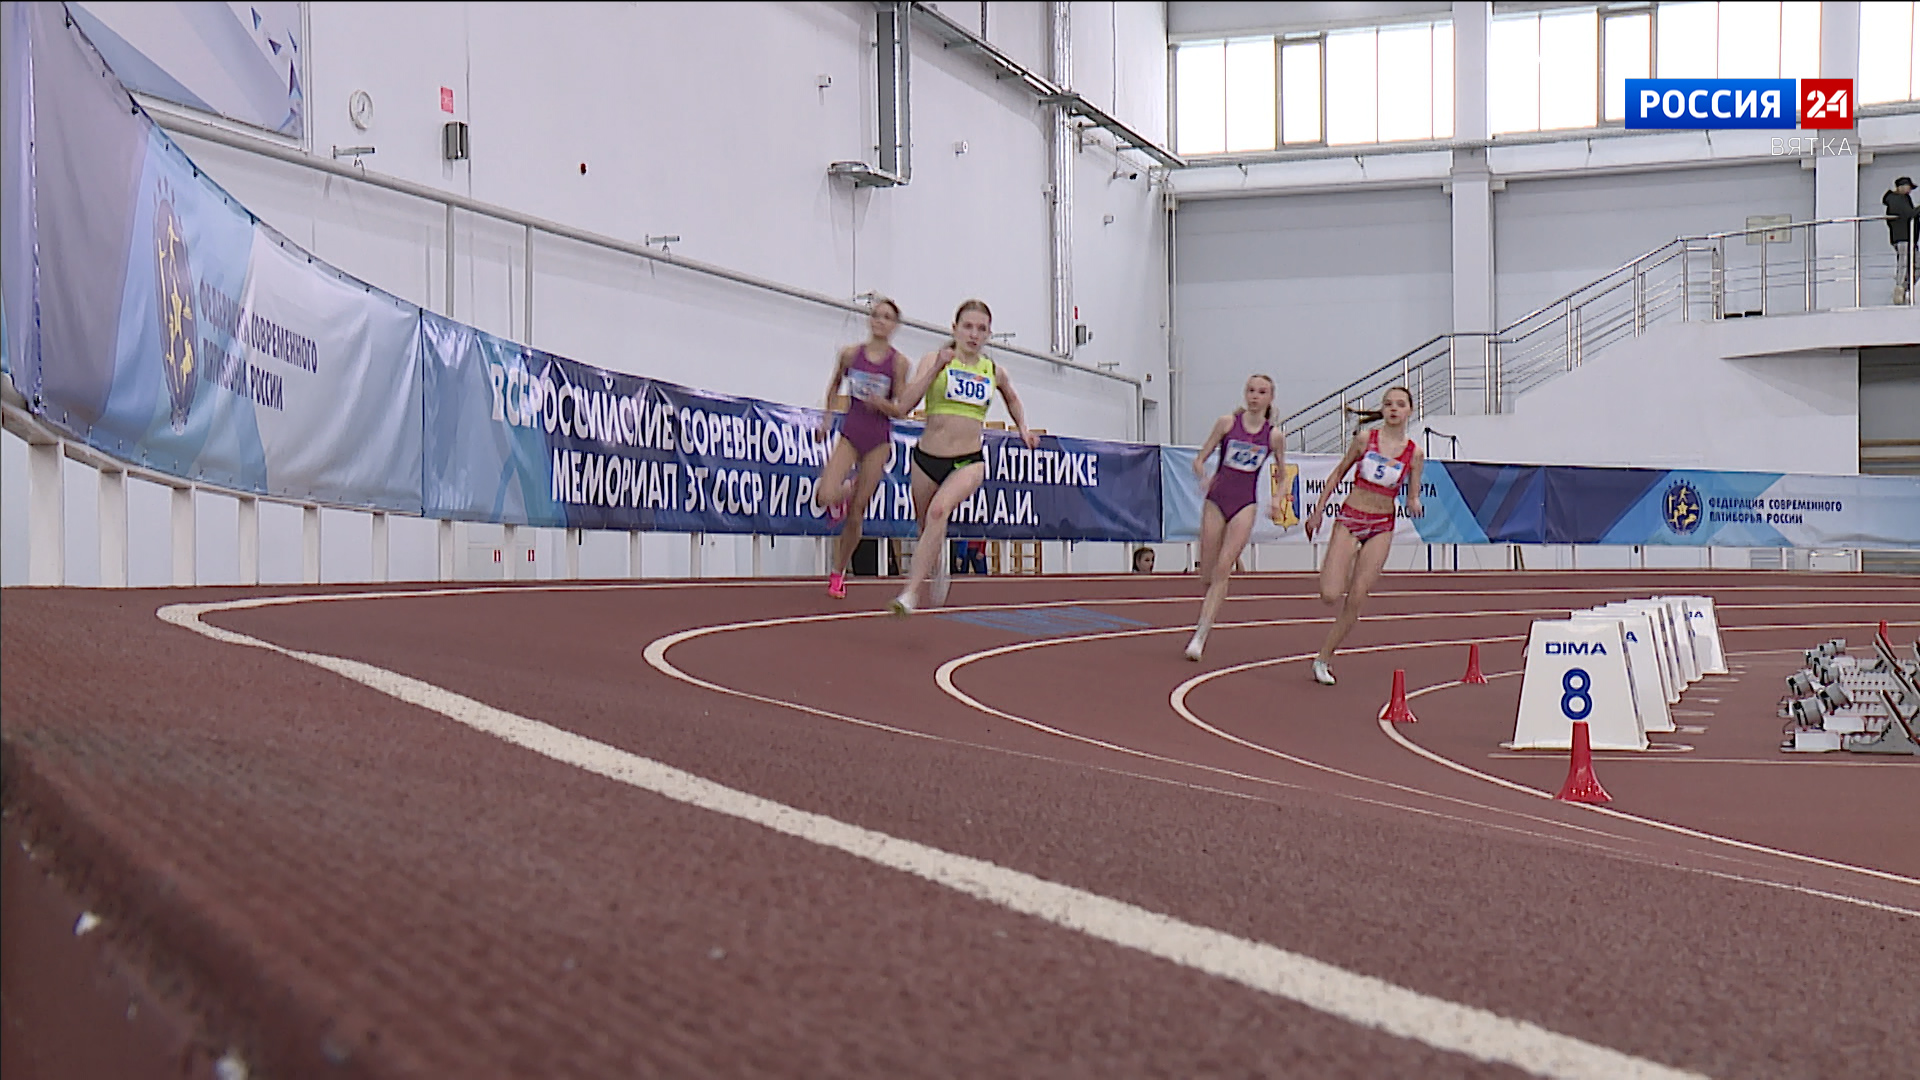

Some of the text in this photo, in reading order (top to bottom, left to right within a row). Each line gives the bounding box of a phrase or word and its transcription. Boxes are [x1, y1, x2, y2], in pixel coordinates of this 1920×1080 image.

[251, 311, 318, 374] СОВРЕМЕННОГО
[250, 363, 283, 411] РОССИИ
[954, 379, 985, 400] 308
[490, 363, 674, 451] ВСЕРОССИЙСКИЕ
[996, 446, 1098, 486] АТЛЕТИКЕ
[552, 448, 678, 511] МЕМОРИАЛ
[712, 467, 764, 517] СССР
[770, 474, 790, 517] И
[993, 489, 1039, 525] А.И.
[1374, 465, 1385, 480] 5
[1708, 497, 1843, 512] ФЕДЕРАЦИЯ СОВРЕМЕННОГО
[1766, 513, 1803, 524] РОССИИ
[1545, 641, 1607, 656] DIMA
[1561, 667, 1593, 720] 8
